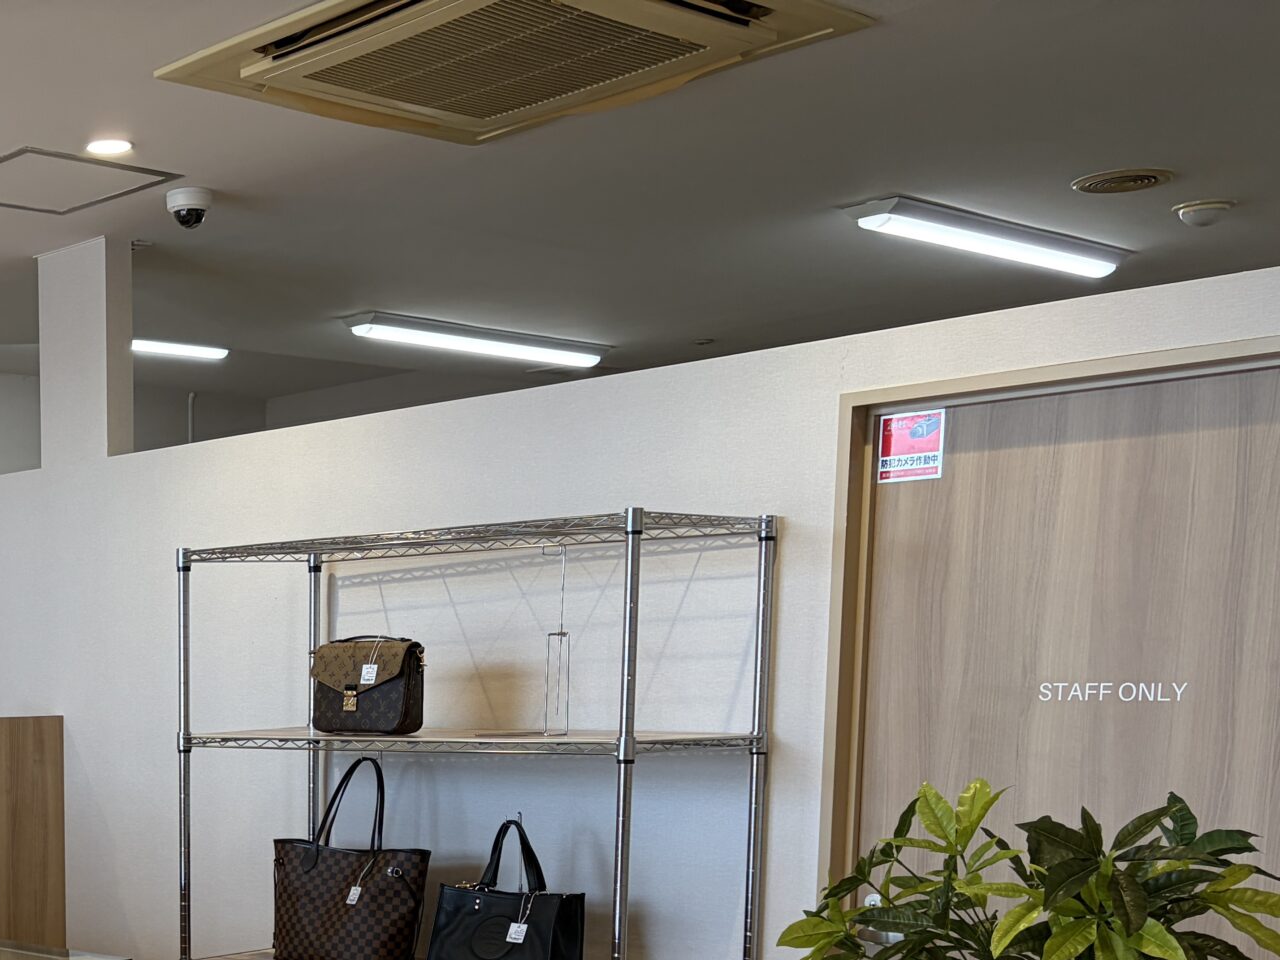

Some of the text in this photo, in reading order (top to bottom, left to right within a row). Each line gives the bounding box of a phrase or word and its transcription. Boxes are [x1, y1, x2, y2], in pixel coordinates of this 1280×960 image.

[880, 454, 939, 470] 防犯カメラ作動中
[1038, 682, 1188, 701] STAFF ONLY
